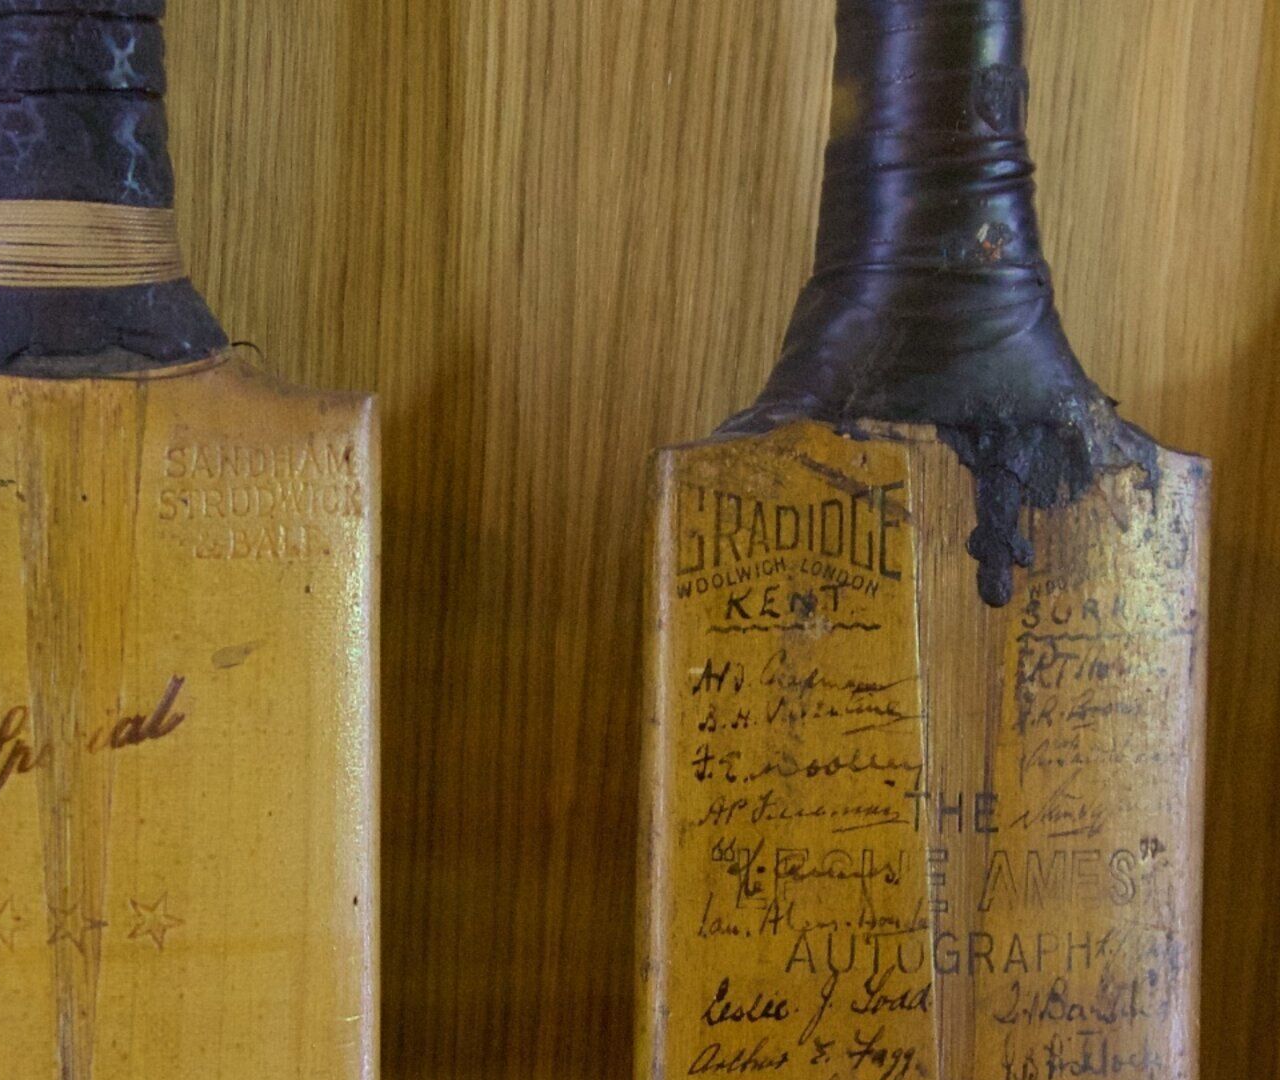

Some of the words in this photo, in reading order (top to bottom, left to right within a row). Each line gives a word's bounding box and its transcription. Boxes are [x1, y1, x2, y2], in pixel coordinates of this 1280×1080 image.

[165, 442, 357, 481] SANDHAM
[158, 481, 363, 523] STRUDWICK
[675, 480, 904, 582] GRADIDGE
[676, 557, 787, 600] WOOLWICH
[800, 558, 879, 598] LONDON
[1020, 597, 1176, 629] SURRY
[904, 790, 1000, 834] THE
[784, 929, 1094, 977] AUTOGRAPH
